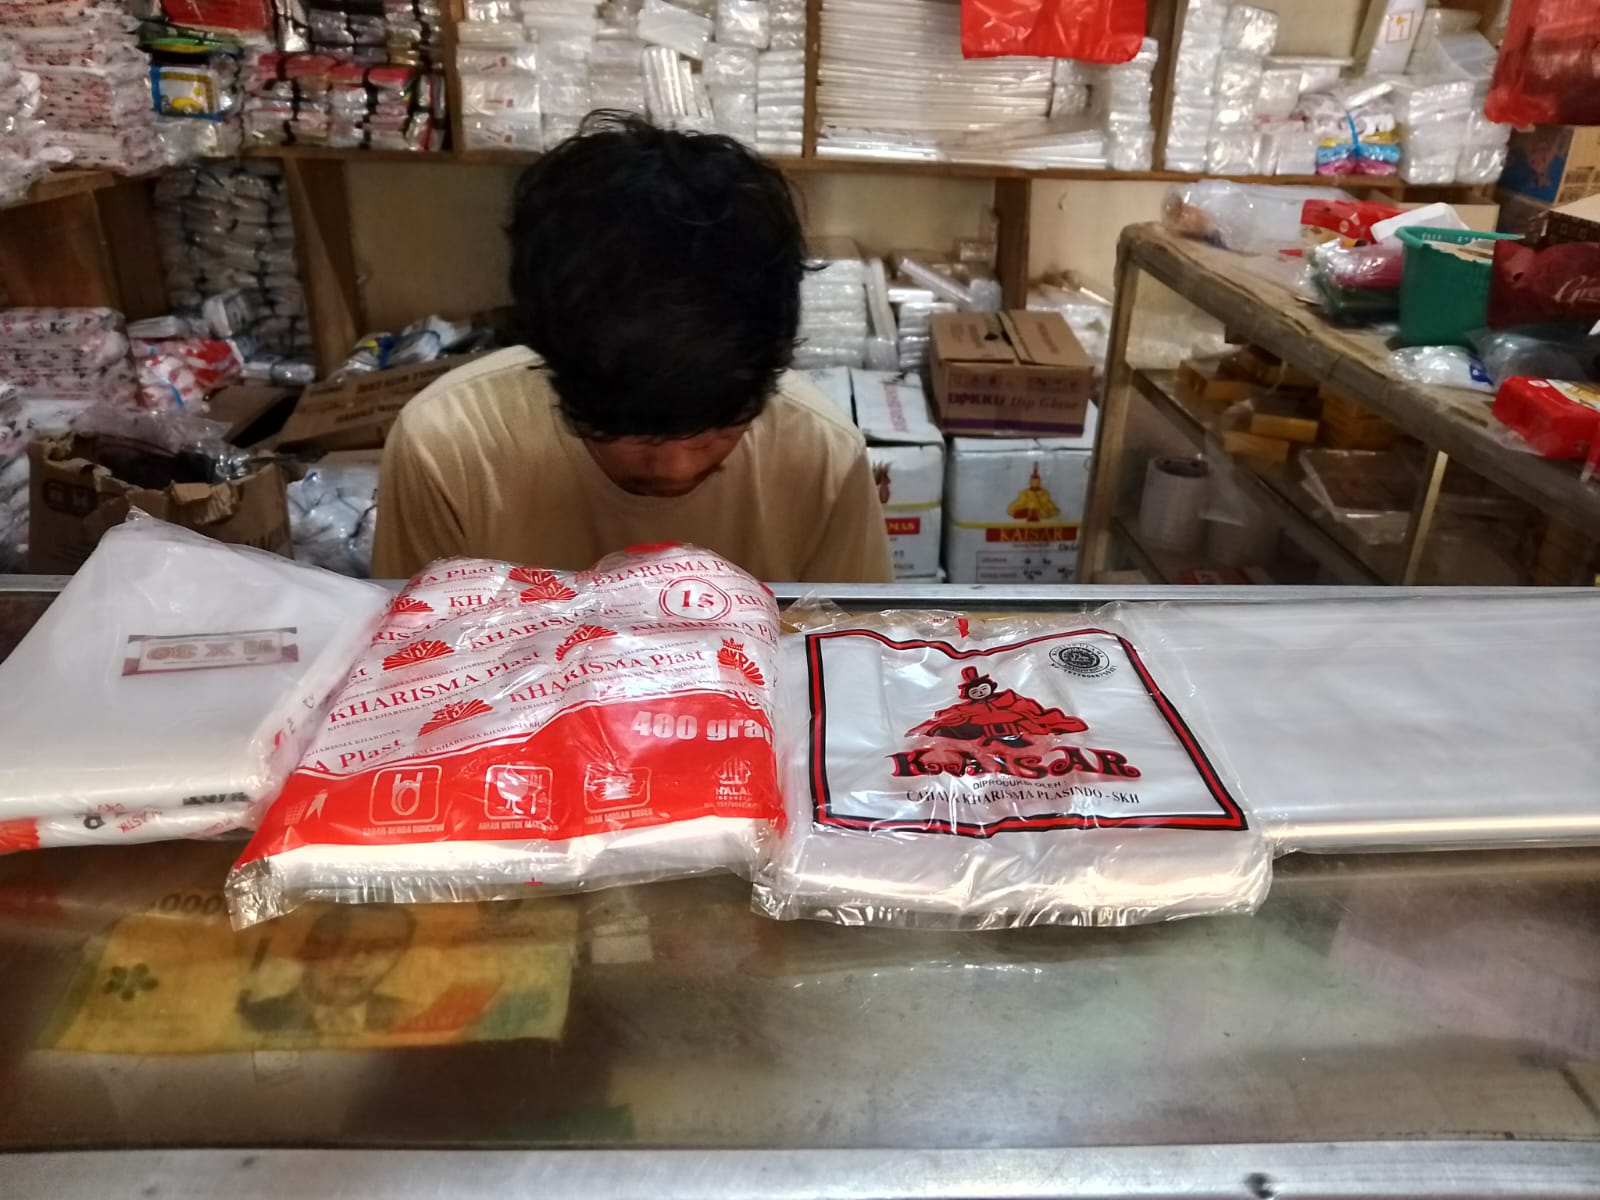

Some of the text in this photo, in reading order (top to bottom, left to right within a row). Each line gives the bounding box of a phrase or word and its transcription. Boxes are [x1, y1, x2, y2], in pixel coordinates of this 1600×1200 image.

[447, 566, 496, 579] Plast
[329, 651, 540, 724] KHARISMA Plast
[509, 649, 705, 703] KHARISMA Plast
[631, 711, 698, 740] 400
[338, 739, 400, 769] Plast
[885, 745, 1142, 780] KAISAR
[962, 788, 1034, 805] KHARISMA
[1036, 785, 1103, 801] PLASINDO
[1111, 791, 1140, 804] SKH
